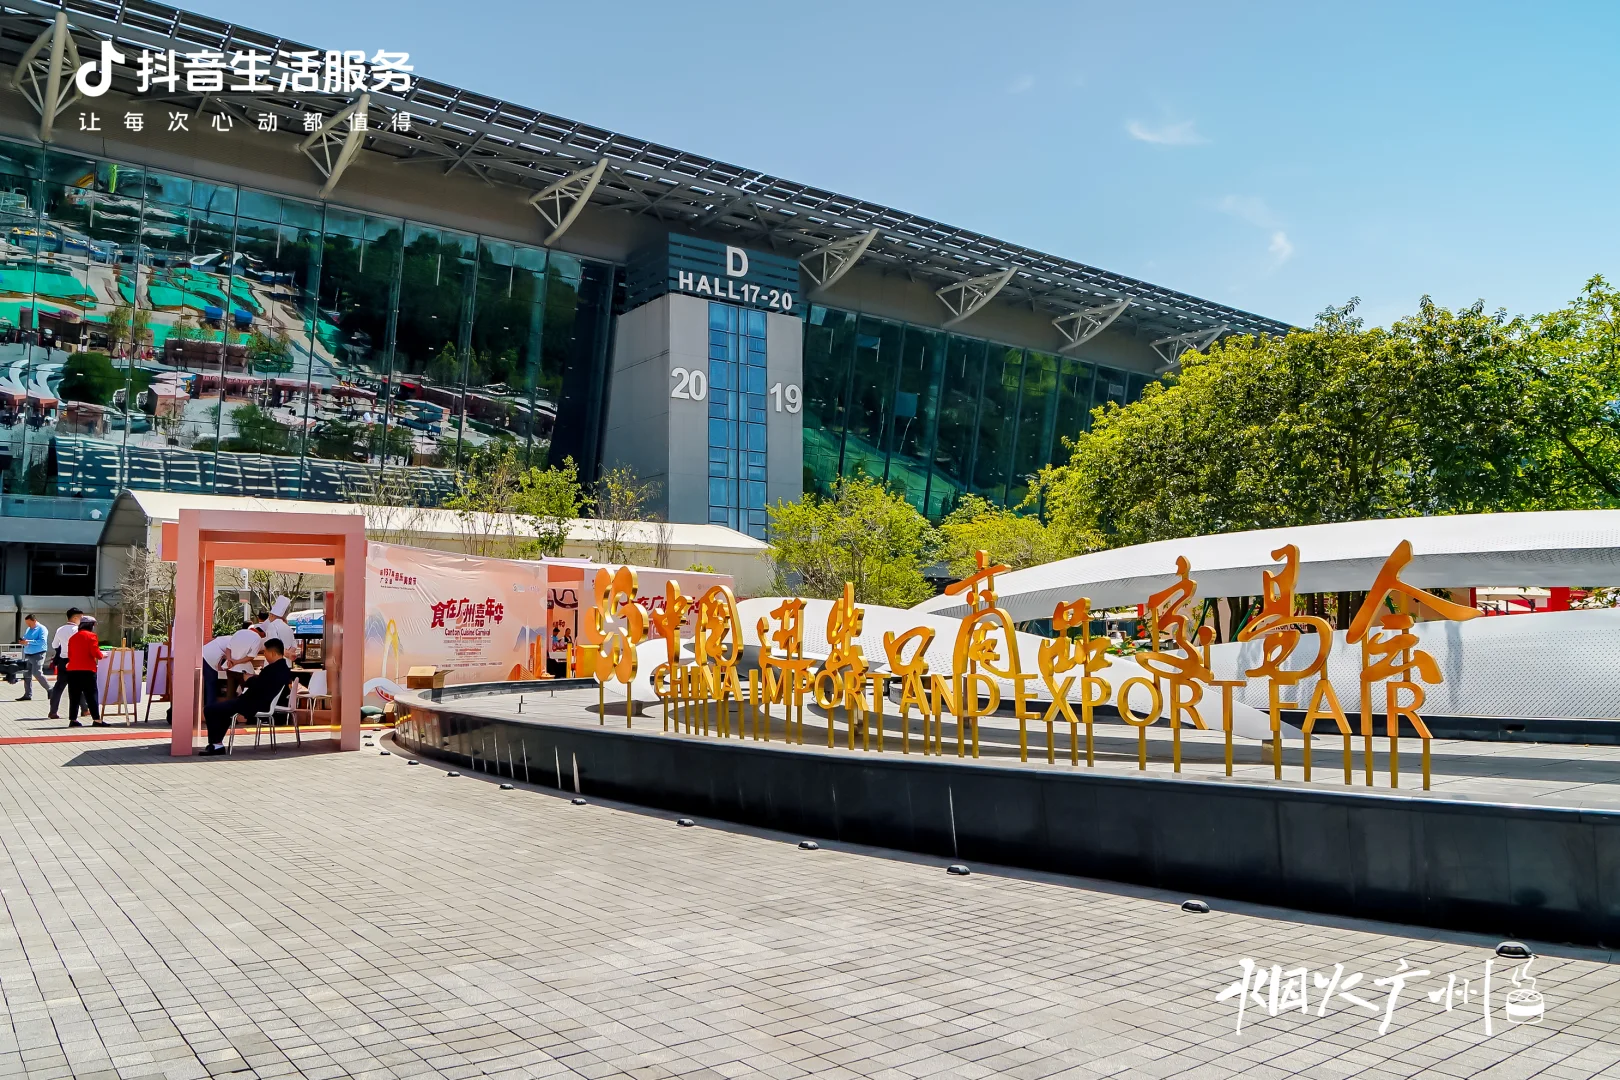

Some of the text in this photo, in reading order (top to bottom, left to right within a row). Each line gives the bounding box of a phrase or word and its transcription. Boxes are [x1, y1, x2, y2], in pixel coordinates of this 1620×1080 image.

[726, 245, 749, 278] D
[670, 367, 708, 401] 20
[769, 382, 803, 414] 19
[653, 663, 1434, 739] CHINA IMPORT AND EXPORT FAIR
